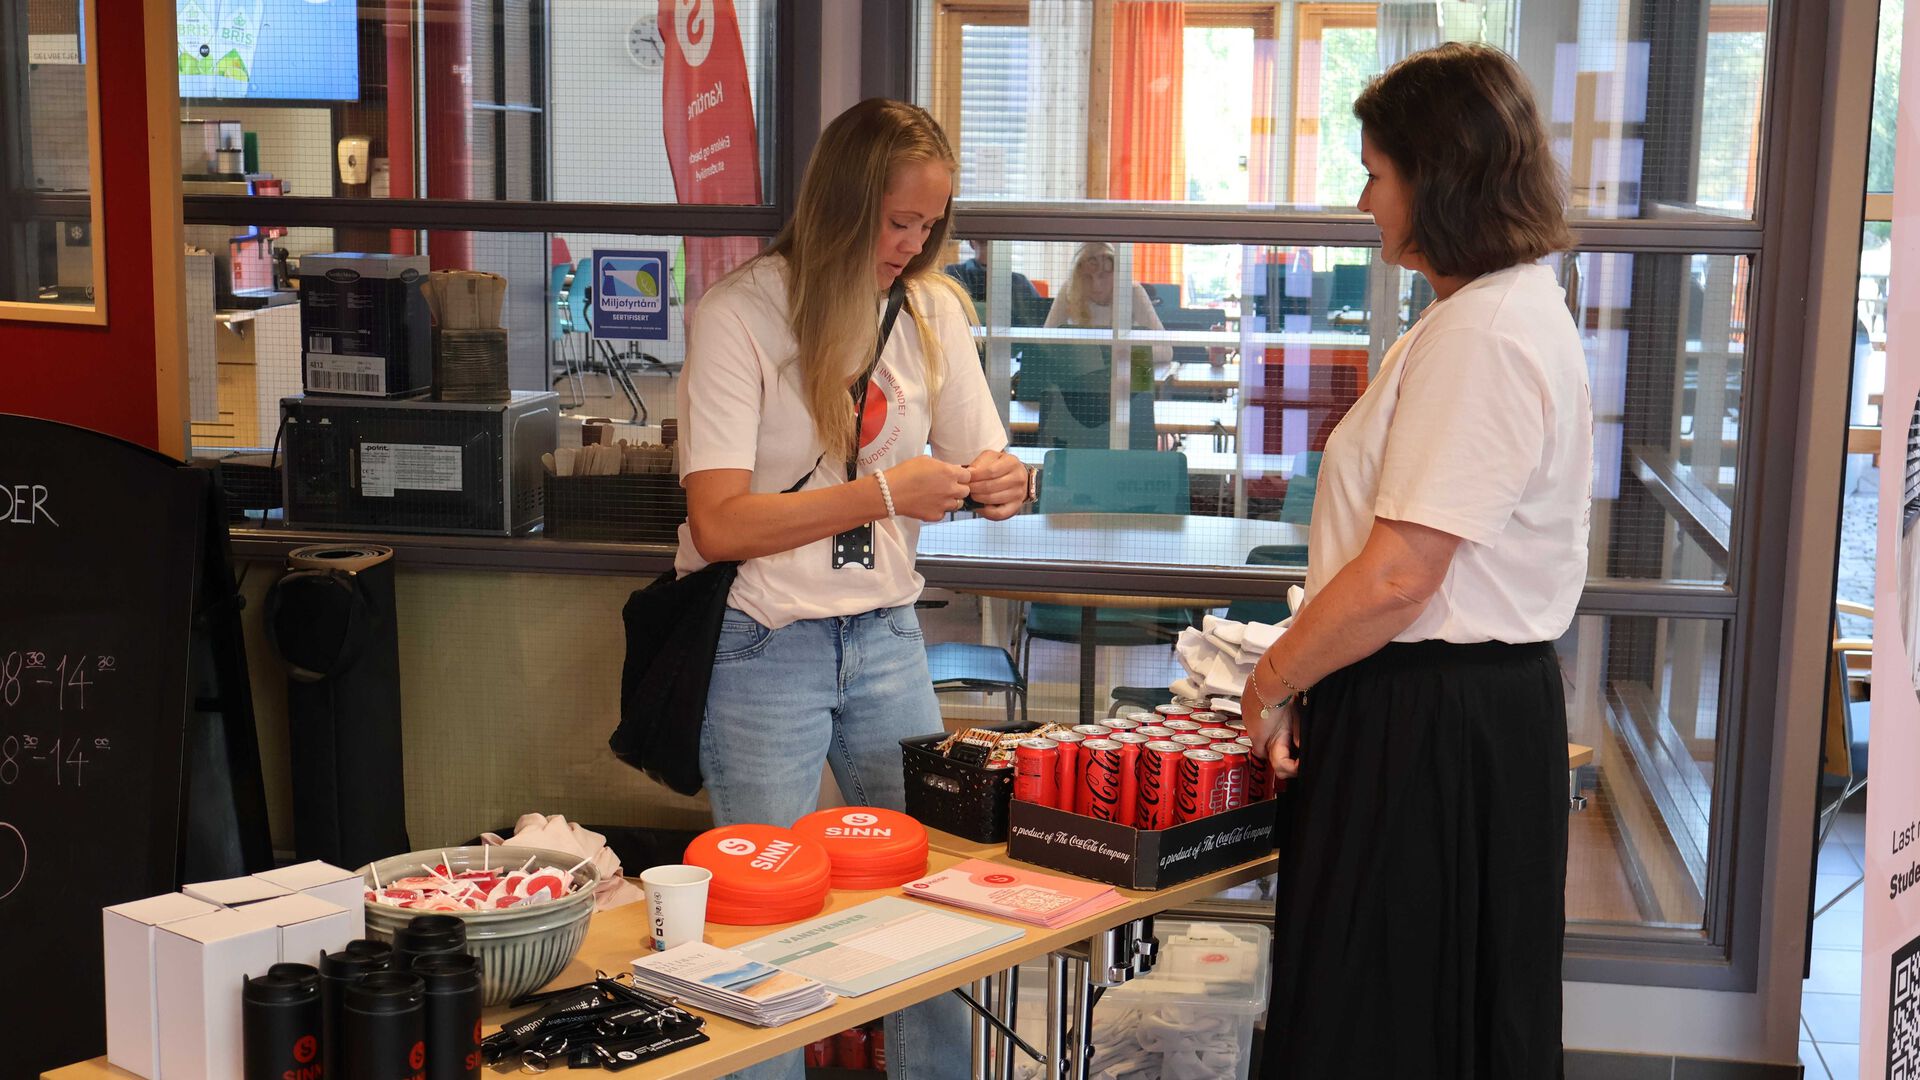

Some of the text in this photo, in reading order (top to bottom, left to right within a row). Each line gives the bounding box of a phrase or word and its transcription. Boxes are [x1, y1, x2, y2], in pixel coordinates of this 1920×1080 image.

[222, 27, 254, 45] BRIS
[601, 297, 657, 309] Miljøfyrtårn
[880, 367, 906, 417] INNLANDET
[824, 827, 891, 837] SINN
[1016, 827, 1044, 839] product
[1044, 833, 1054, 844] of
[1054, 831, 1067, 844] The
[1099, 842, 1130, 863] Company
[1160, 857, 1166, 866] a
[1164, 847, 1192, 869] product
[1191, 842, 1202, 859] of
[1201, 834, 1215, 853] The
[1243, 824, 1272, 841] Company
[1892, 821, 1915, 854] Last
[750, 839, 794, 870] SINN
[1890, 861, 1920, 900] Stude
